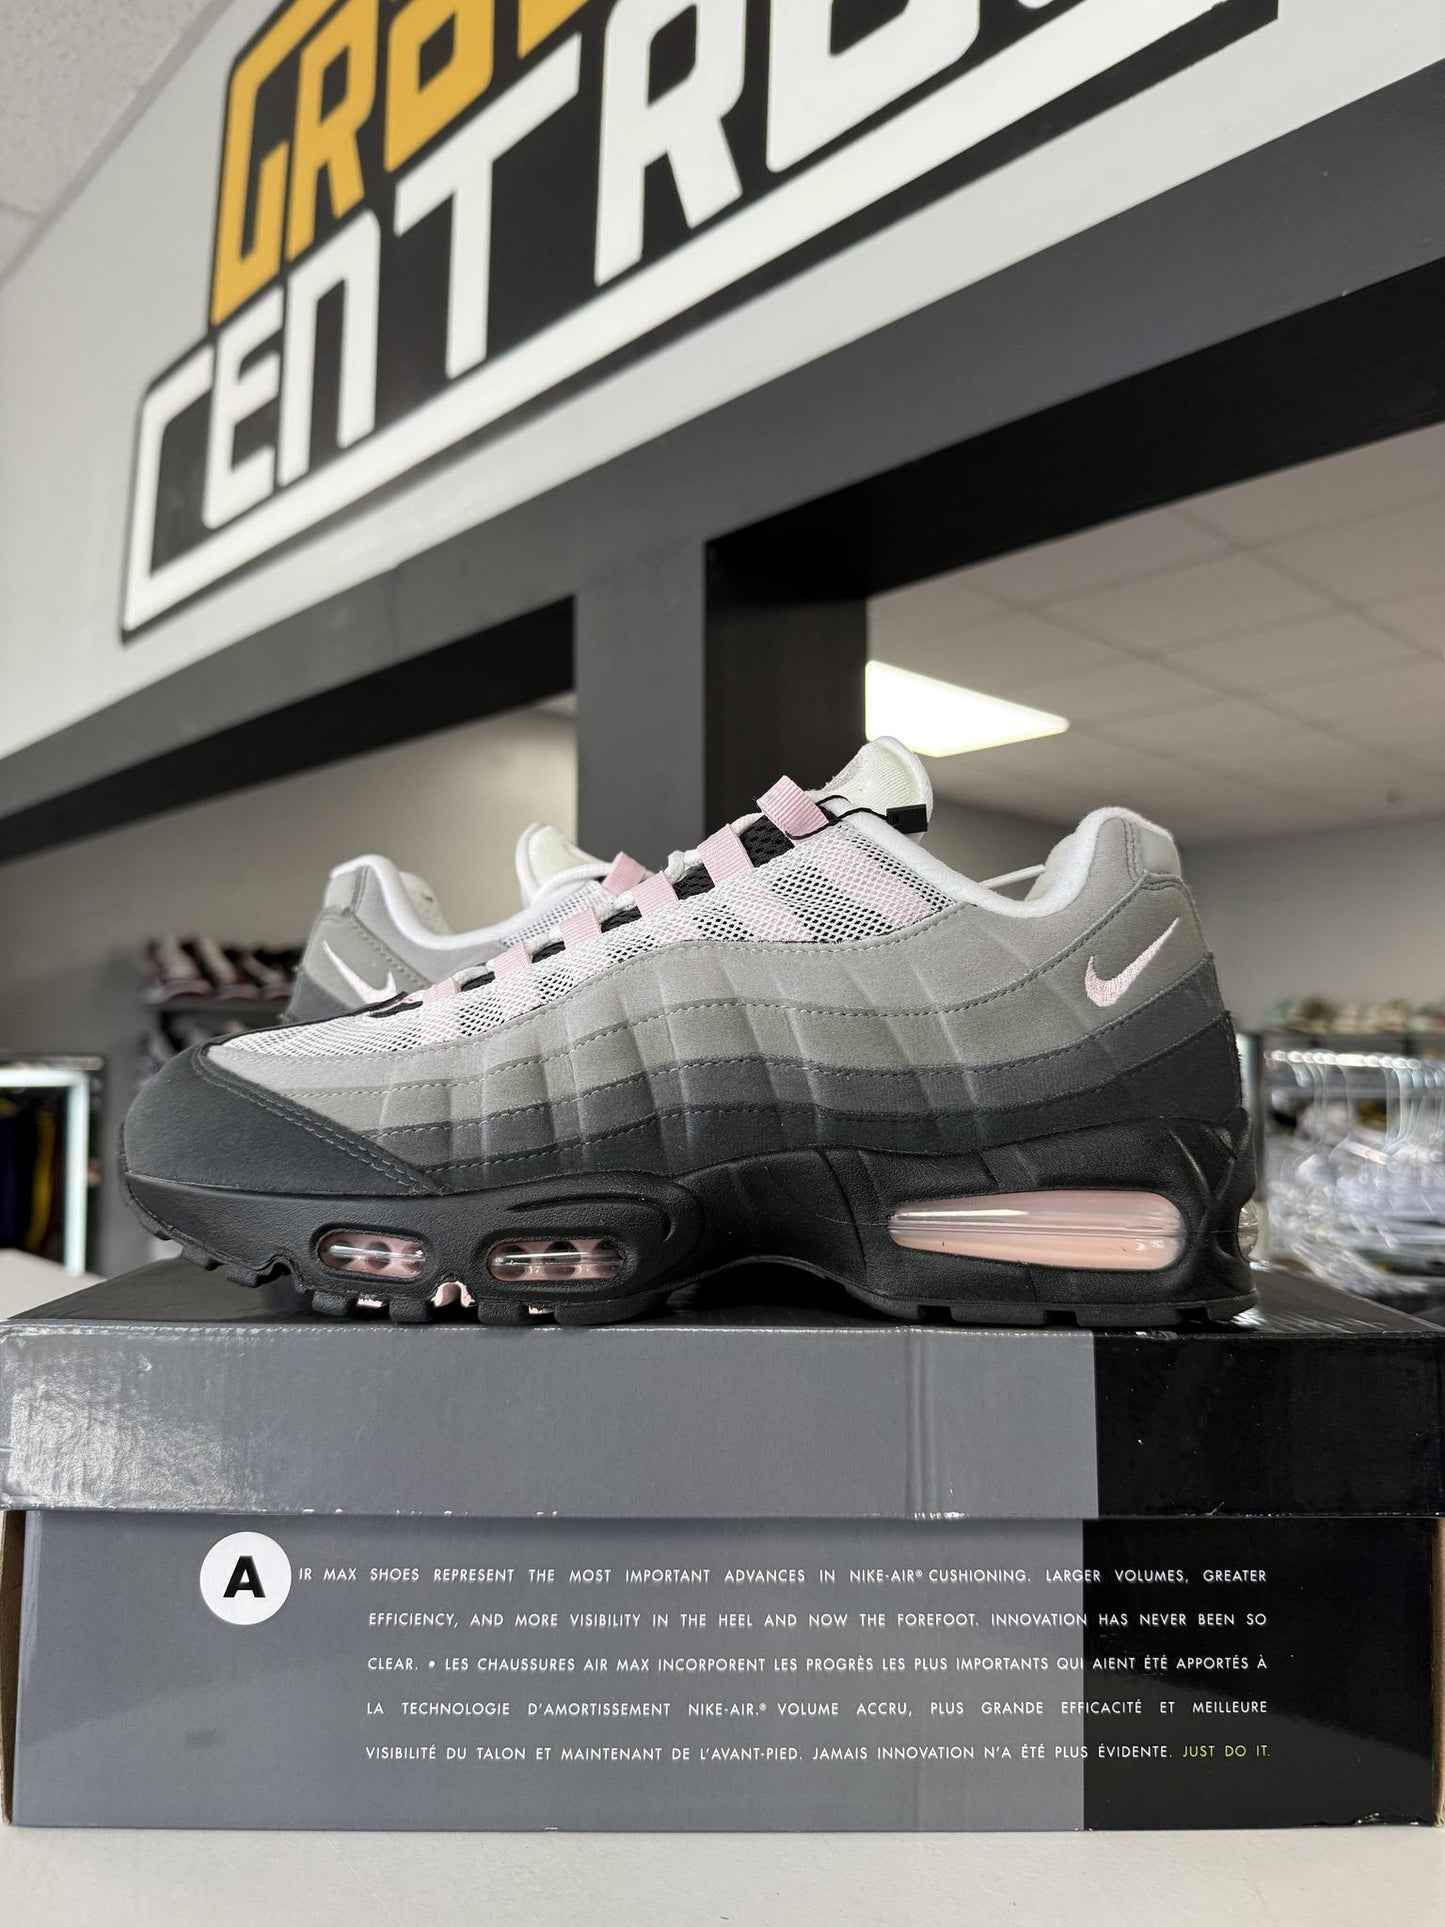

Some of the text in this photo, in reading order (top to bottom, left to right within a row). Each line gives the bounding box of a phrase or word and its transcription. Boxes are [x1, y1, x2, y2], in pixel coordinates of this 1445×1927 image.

[223, 1555, 266, 1599] A
[323, 1567, 357, 1581] MAX
[369, 1567, 420, 1582] SHOES
[433, 1568, 515, 1583] REPRESENT
[528, 1568, 555, 1583] THE
[568, 1568, 612, 1584] MOST
[625, 1568, 711, 1584] IMPORTANT
[724, 1568, 805, 1584] ADVANCES
[819, 1569, 836, 1584] IN
[928, 1568, 1031, 1583] CUSHIONING.
[1046, 1568, 1102, 1584] LARGER
[1114, 1568, 1189, 1585] VOLUMES,
[1202, 1569, 1267, 1584] GREATER
[368, 1612, 1268, 1629] EFFICIENCY, AND MORE VISIBILITY IN THE HEEL AND NOW THE FOREFOOT. INNOVATION HAS NEVER BEEN SO
[367, 1653, 1268, 1672] CLEAR. LES CHAUSSURES AIR MAX INCORPORENT LES PROGRÈS LES PLUS IMPORTANTS QUI AIENT ÉTÉ APPORTÉS À
[366, 1702, 385, 1715] LA
[401, 1702, 510, 1716] TECHNOLOGIE
[527, 1702, 671, 1717] D'AMORTISSEMENT
[777, 1702, 839, 1716] VOLUME
[856, 1701, 912, 1717] ACCRU,
[930, 1701, 964, 1715] PLUS
[981, 1701, 1044, 1715] GRANDE
[1061, 1698, 1142, 1715] EFFICACITÉ
[1159, 1701, 1176, 1714] ET
[1192, 1700, 1268, 1714] MEILLEURE
[365, 1742, 1271, 1761] VISIBILITÉ DU TALON ET MAINTENANT DE L'AVANT-PIED. JAMAIS INNOVATION N'A ÉTÉ PLUS ÉVIDENTE. JUST DO IT.
